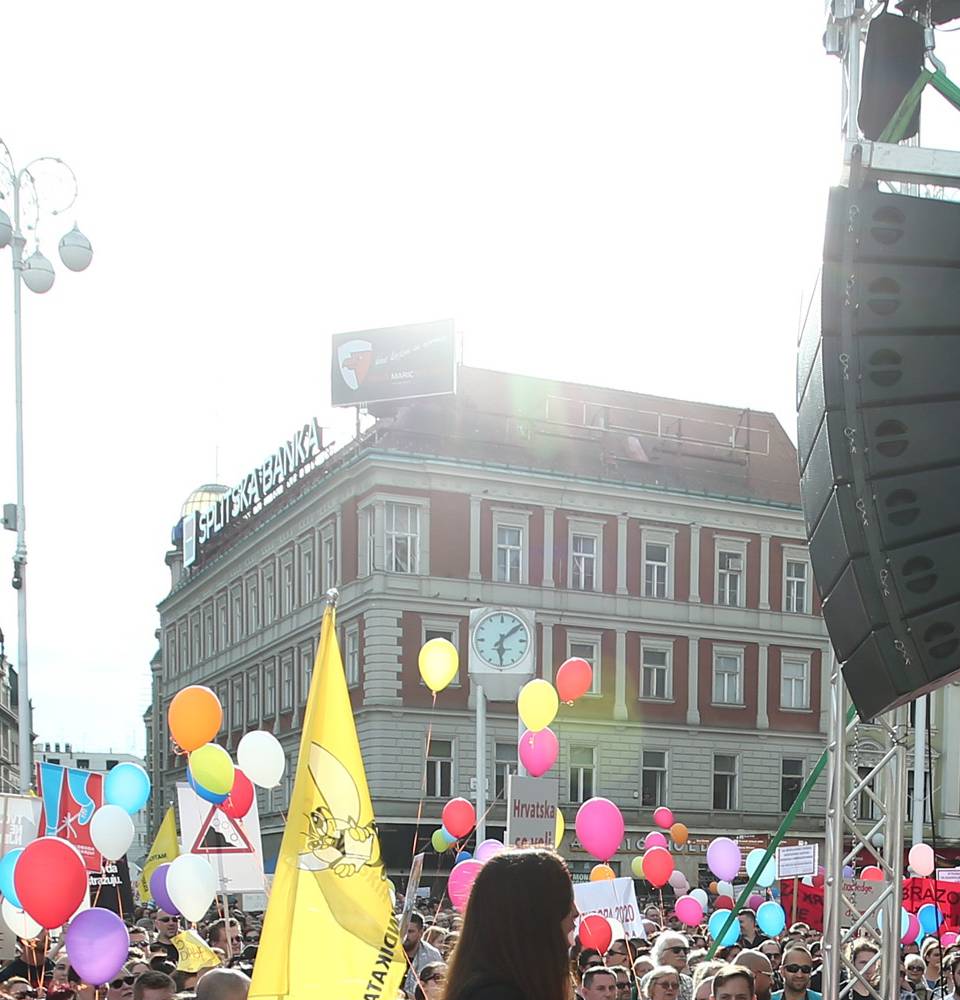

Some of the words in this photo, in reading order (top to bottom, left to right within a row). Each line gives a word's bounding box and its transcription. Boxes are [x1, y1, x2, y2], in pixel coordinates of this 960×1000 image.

[198, 467, 260, 544] SPLITSKA
[262, 416, 321, 496] BANKA
[512, 799, 555, 819] Hrvatska
